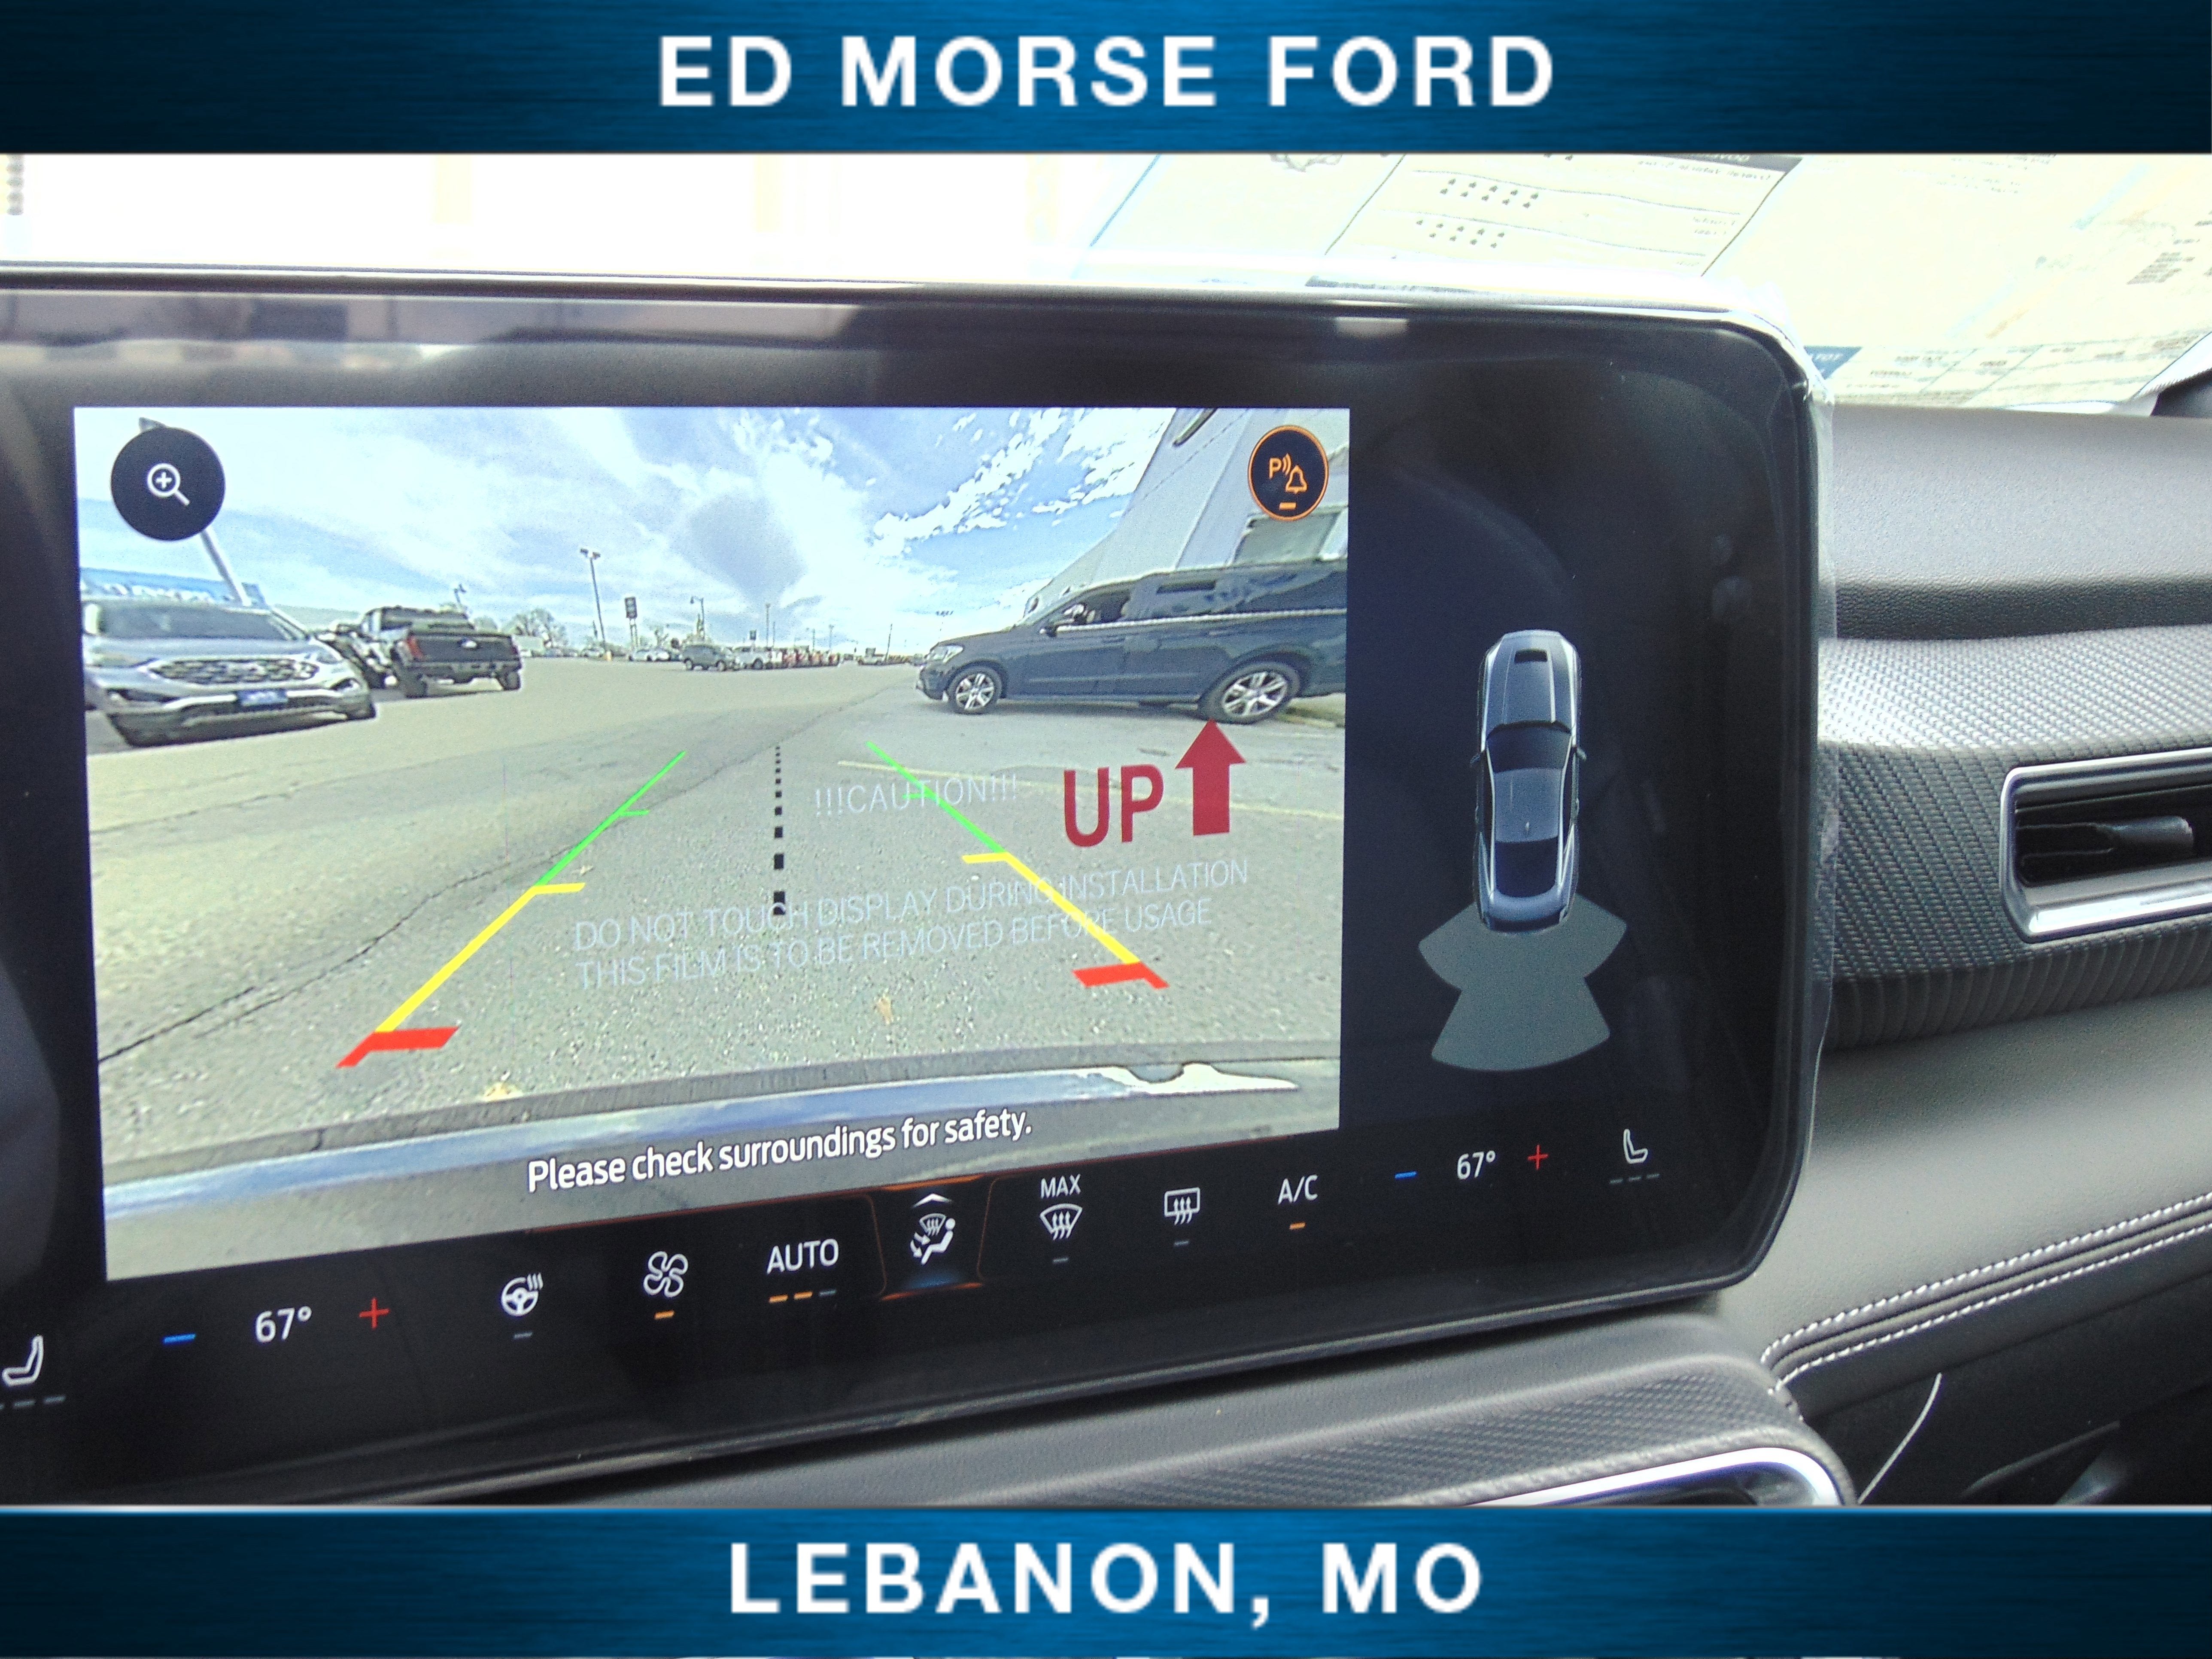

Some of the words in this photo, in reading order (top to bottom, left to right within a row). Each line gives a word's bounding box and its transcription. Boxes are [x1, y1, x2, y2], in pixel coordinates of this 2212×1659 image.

[816, 774, 1016, 816] !!!CAUTION!!!
[1063, 764, 1164, 848] UP
[575, 918, 621, 951] DO
[629, 912, 693, 944] NOT
[703, 901, 809, 936] TOUCH
[819, 888, 937, 927] DISPLAY
[947, 876, 1052, 914] DURING
[1062, 860, 1247, 901] INSTALLATION
[575, 956, 646, 990] THIS
[656, 948, 726, 982] FILM
[736, 945, 761, 972] IS
[772, 939, 808, 969] TO
[818, 934, 854, 965] BE
[863, 920, 1003, 960] REMOVED
[1012, 907, 1117, 943] BEFORE
[1125, 897, 1212, 932] USAGE
[528, 1158, 626, 1193] Please
[632, 1141, 714, 1180] check
[718, 1125, 896, 1170] surroundings
[901, 1117, 940, 1149] for
[945, 1108, 1032, 1143] safety.
[1456, 1150, 1496, 1181] 67°
[1040, 1173, 1082, 1198] MAX
[1277, 1173, 1319, 1206] A/C
[766, 1238, 839, 1274] AUTO
[255, 1305, 313, 1343] 67°
